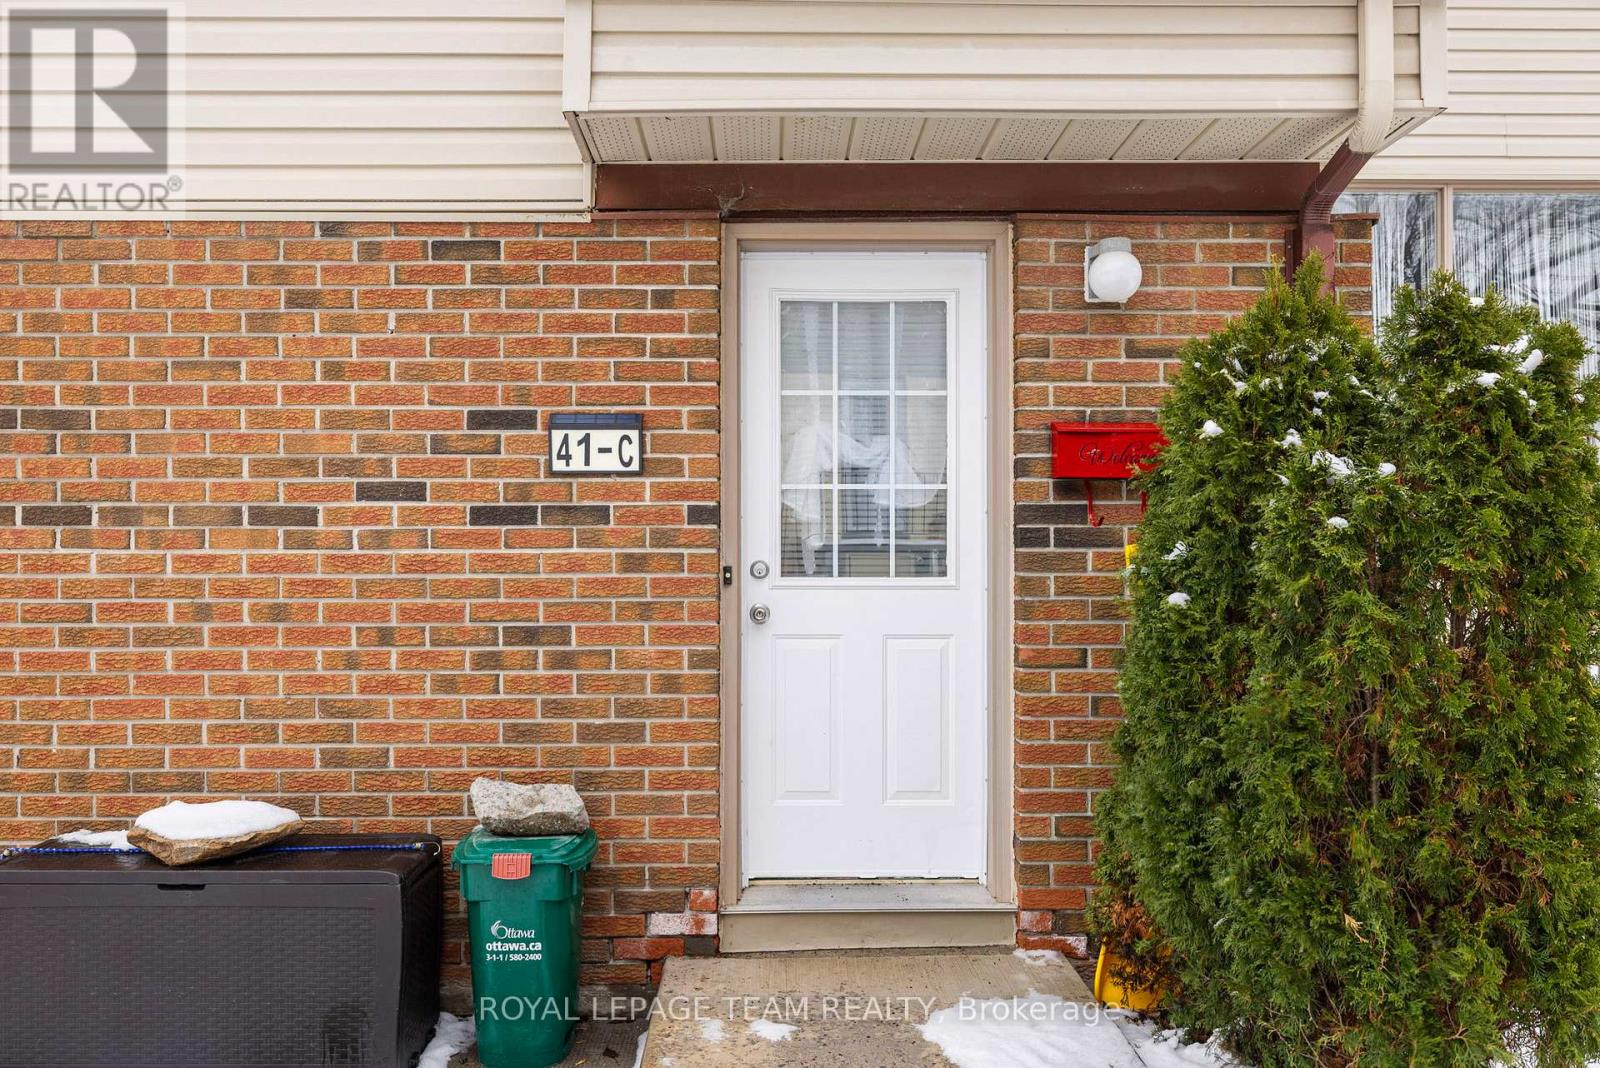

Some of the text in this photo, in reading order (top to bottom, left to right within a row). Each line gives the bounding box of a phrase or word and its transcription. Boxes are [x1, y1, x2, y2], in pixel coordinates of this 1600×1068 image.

[556, 432, 634, 468] 41-C
[491, 920, 535, 939] Ottawa
[486, 941, 542, 951] ottawa.ca
[486, 953, 503, 961] 3-1-1
[509, 953, 542, 961] 580-2400
